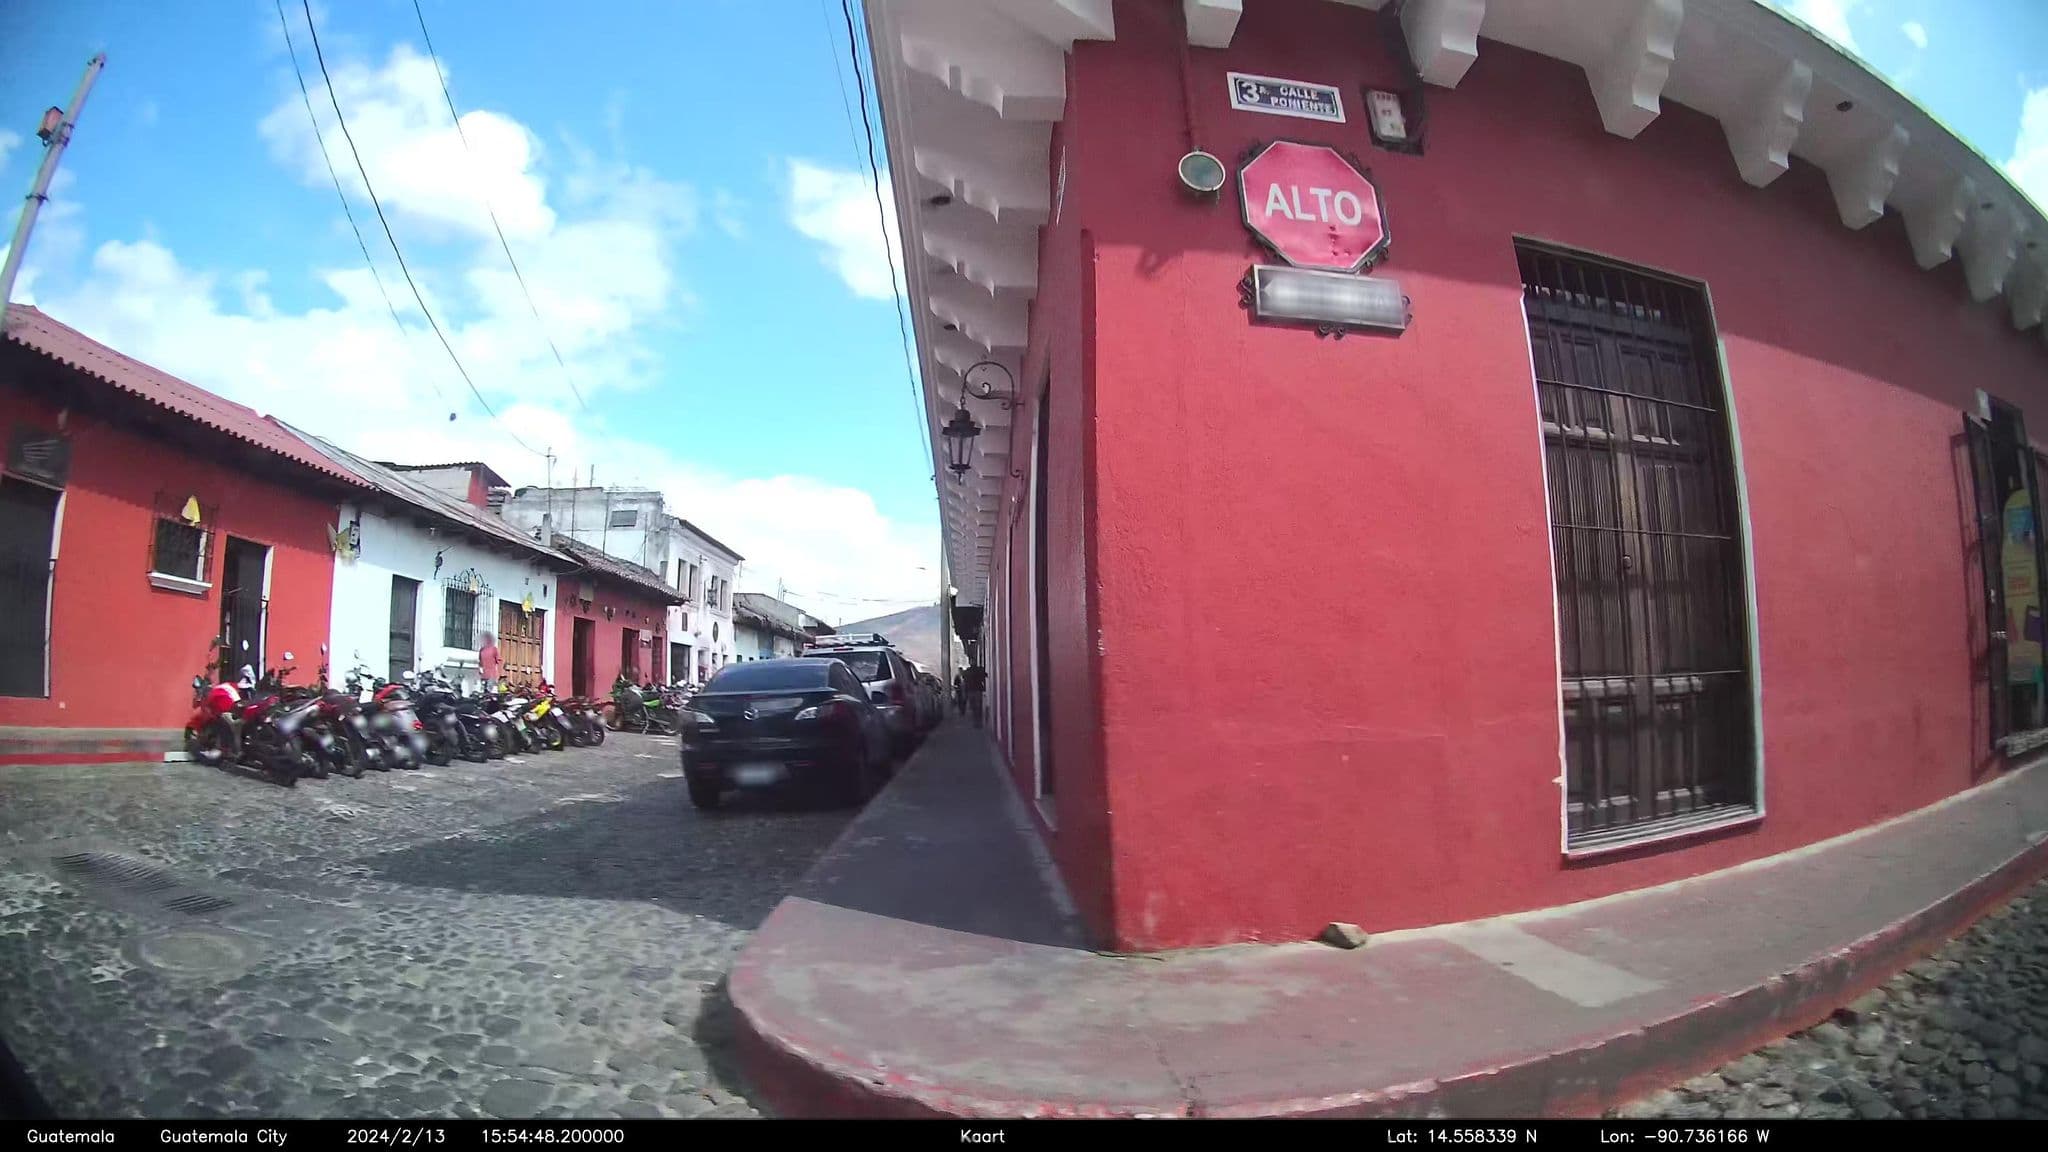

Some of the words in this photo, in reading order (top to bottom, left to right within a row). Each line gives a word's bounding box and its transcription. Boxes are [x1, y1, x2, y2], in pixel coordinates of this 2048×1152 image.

[1280, 86, 1319, 101] CALLE
[1270, 97, 1333, 113] PONIENTE
[1265, 183, 1362, 226] ALTO
